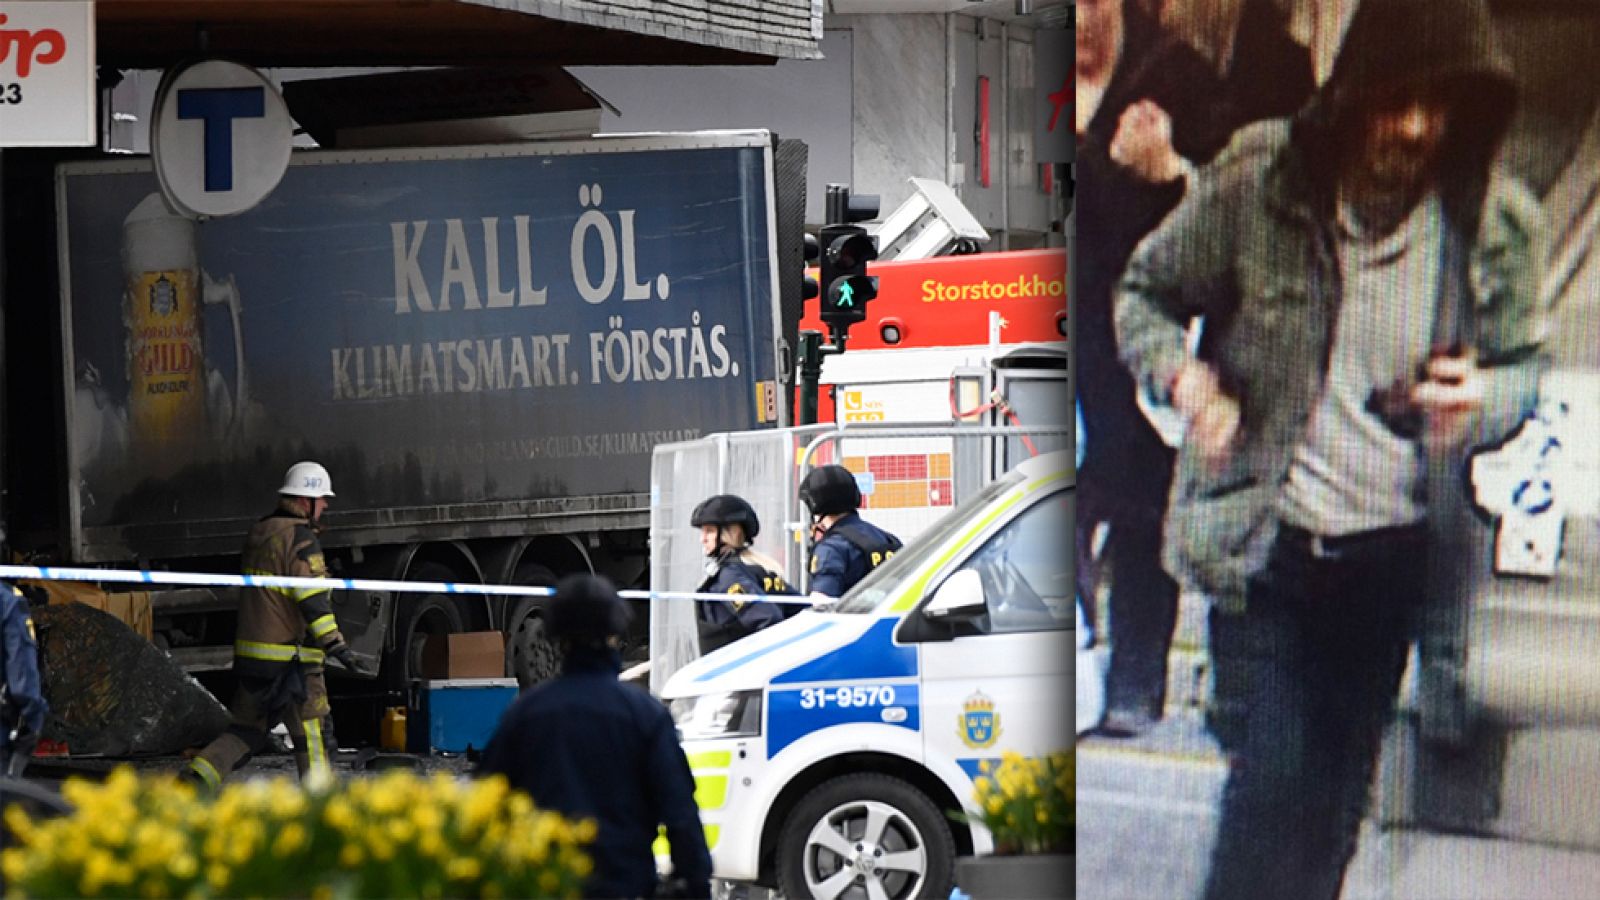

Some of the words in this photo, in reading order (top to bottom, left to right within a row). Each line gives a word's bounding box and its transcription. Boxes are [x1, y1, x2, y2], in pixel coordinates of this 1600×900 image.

[177, 87, 265, 192] T
[390, 214, 548, 314] KALL
[569, 183, 670, 305] ÖL.
[331, 333, 579, 400] KLIMATSMART.
[589, 310, 740, 384] FÖRSTÅS.
[800, 685, 896, 709] 31-9570
